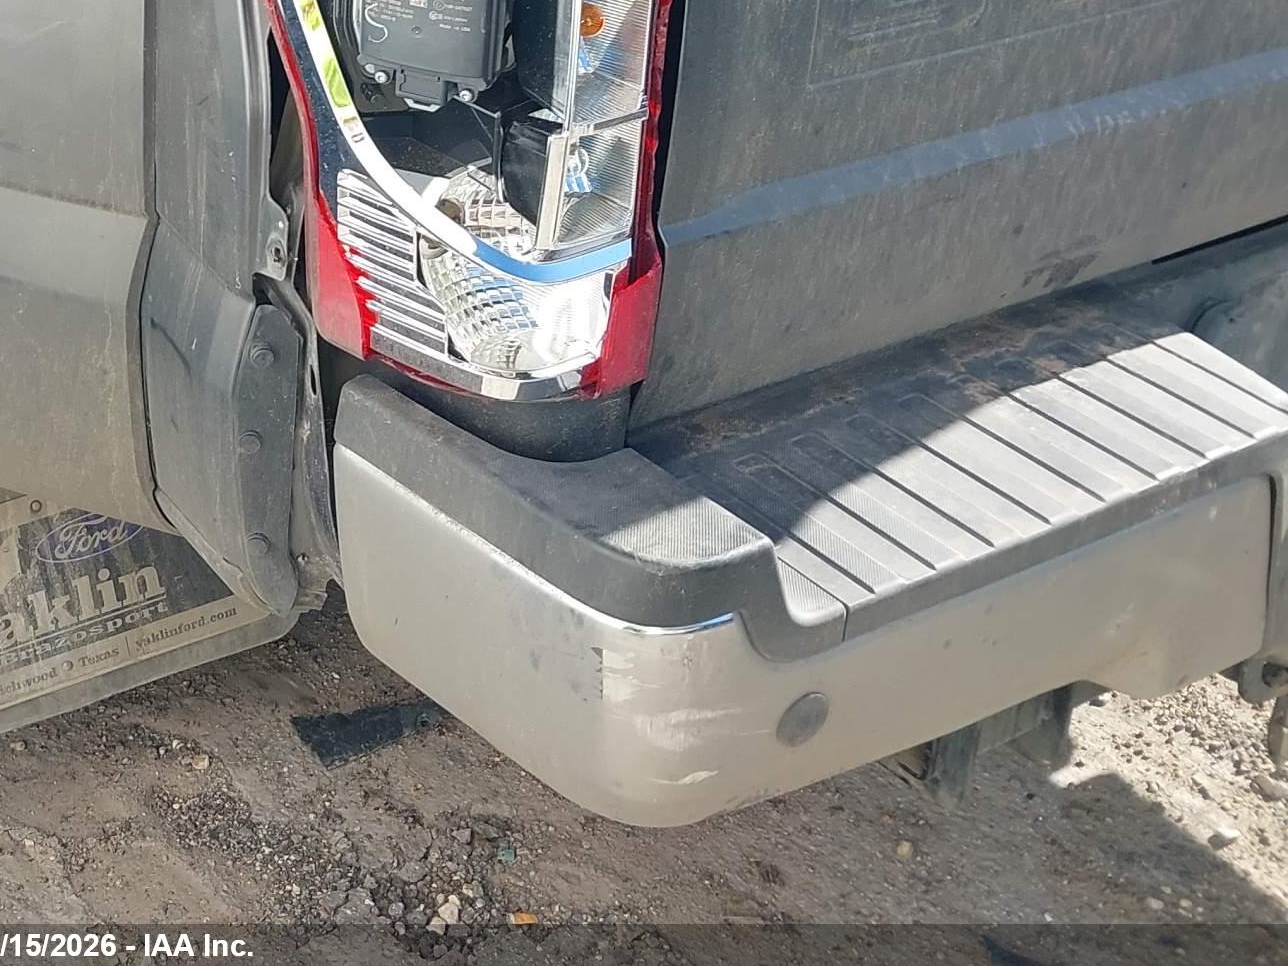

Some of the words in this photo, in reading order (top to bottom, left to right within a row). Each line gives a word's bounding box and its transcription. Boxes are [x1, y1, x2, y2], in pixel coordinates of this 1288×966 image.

[54, 515, 128, 559] Ford
[78, 647, 120, 668] Texas
[135, 606, 238, 652] yaklinford.com
